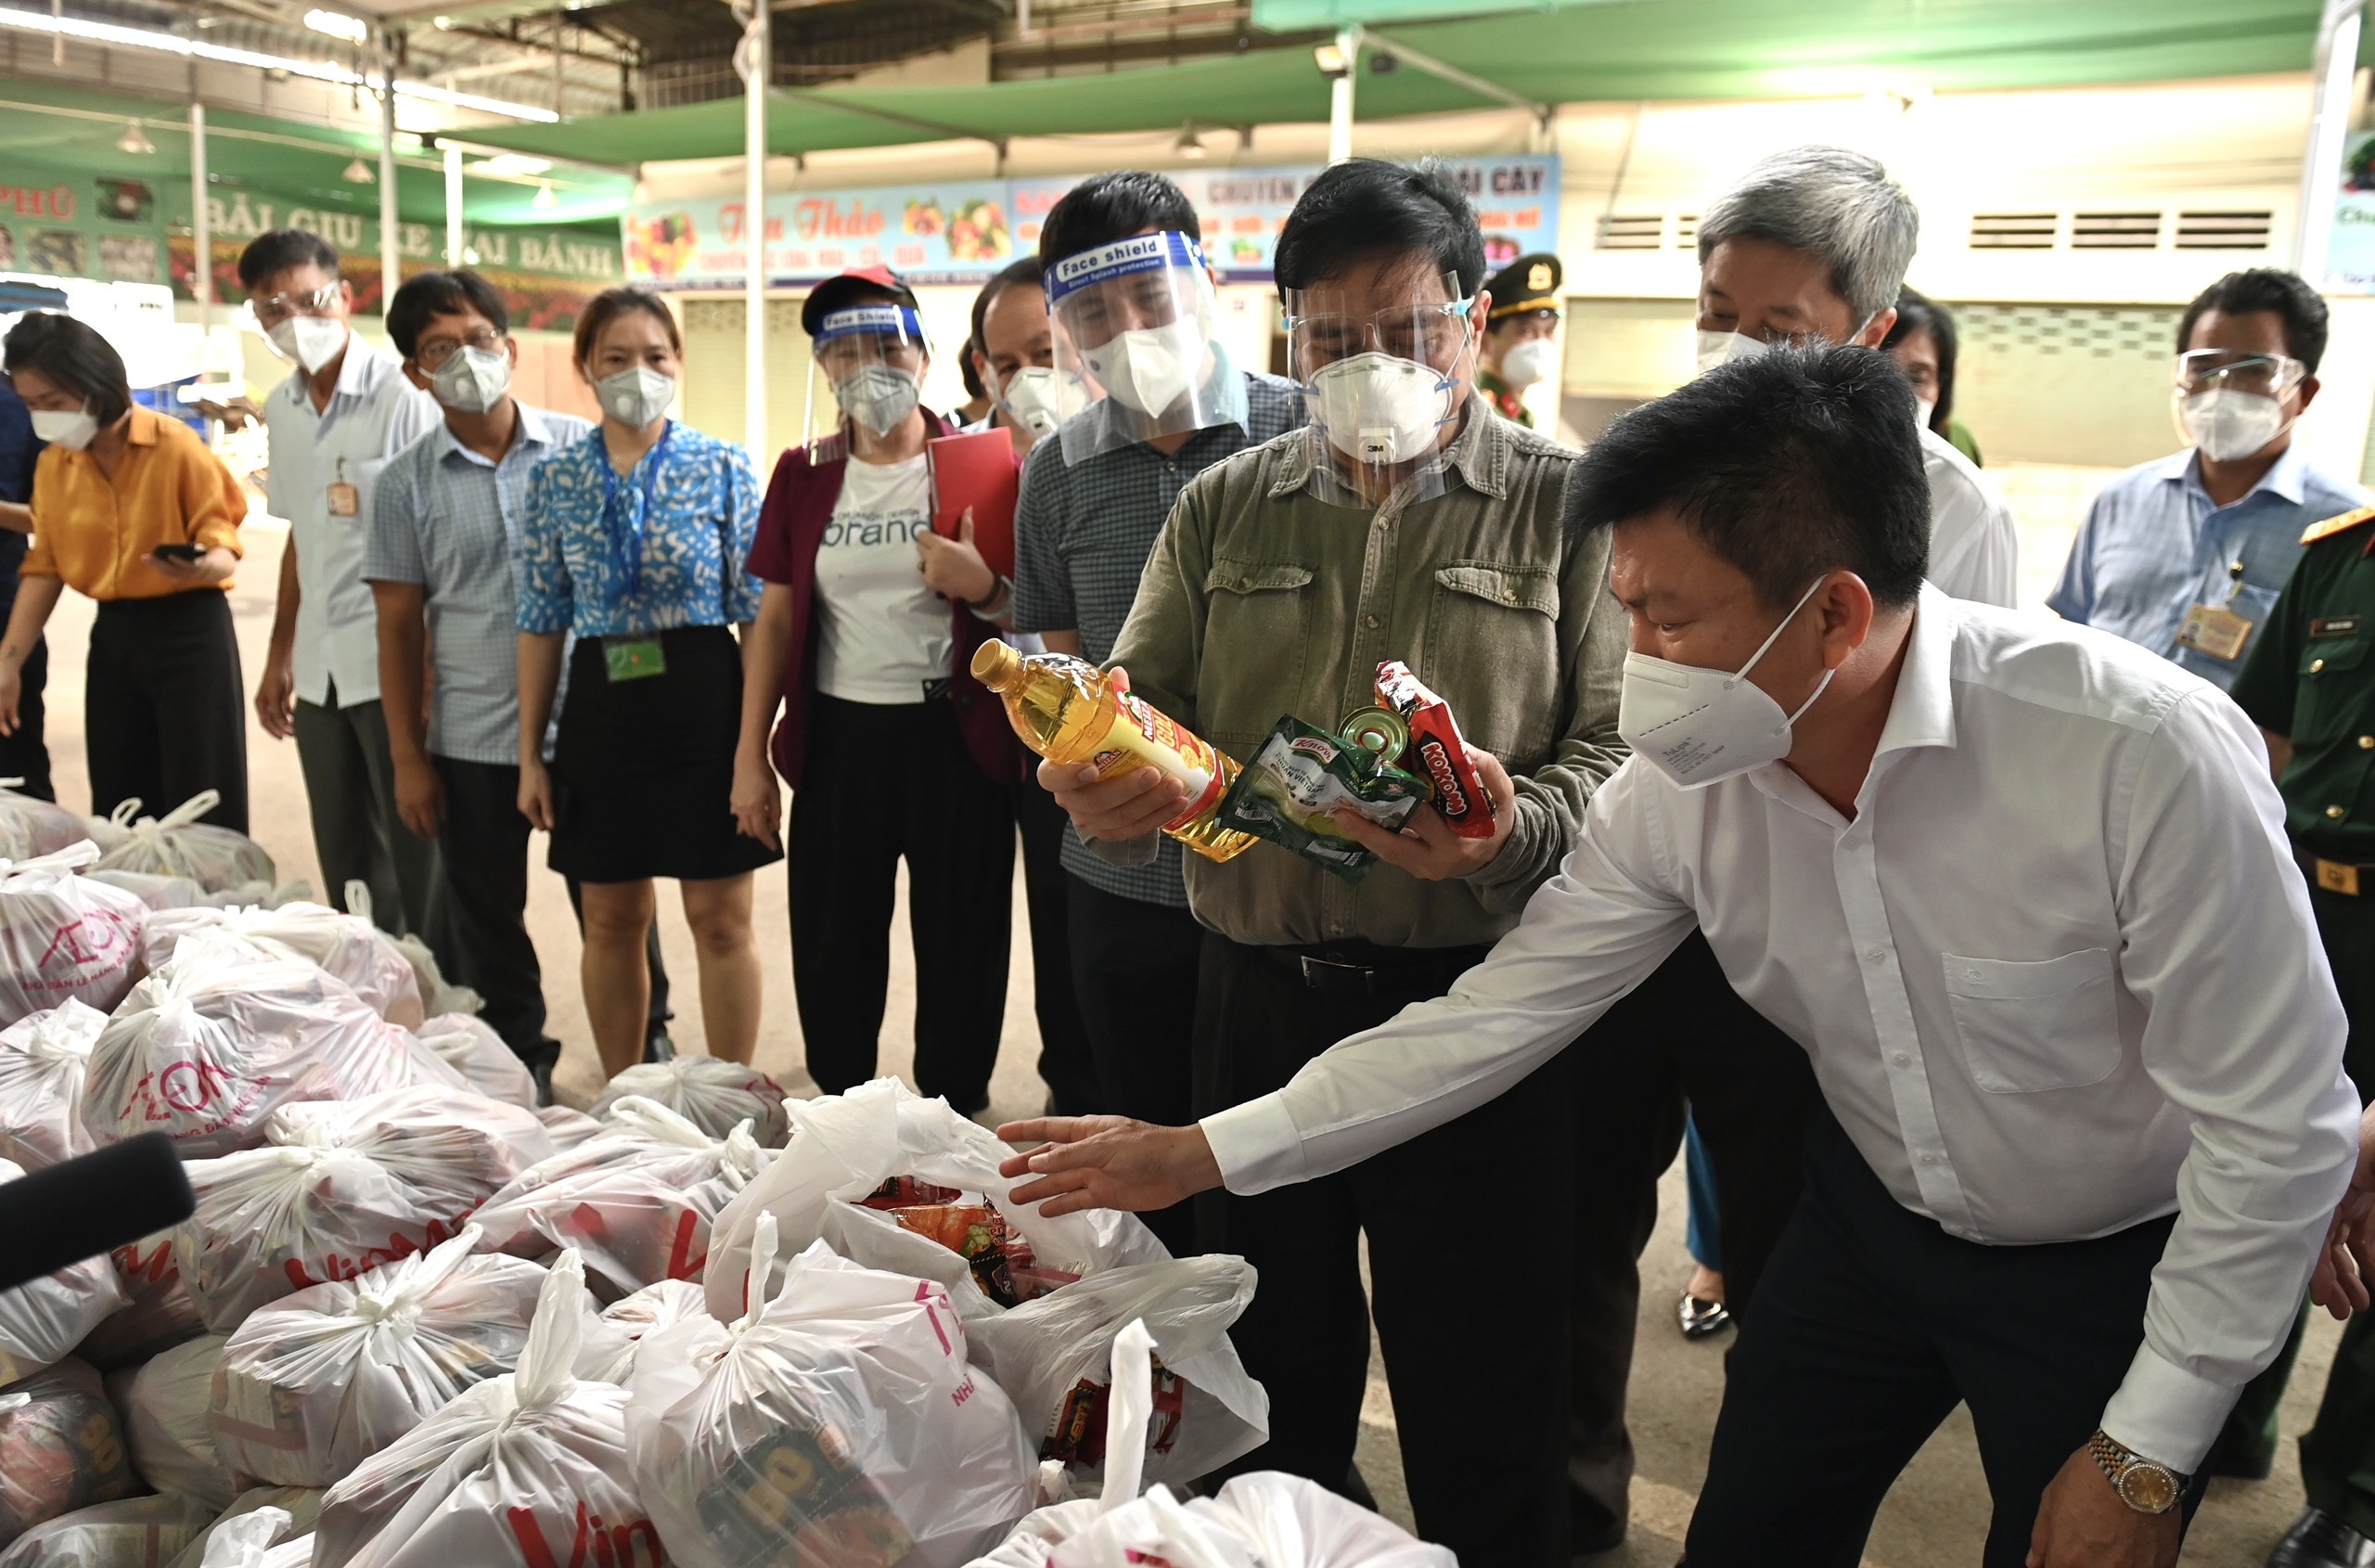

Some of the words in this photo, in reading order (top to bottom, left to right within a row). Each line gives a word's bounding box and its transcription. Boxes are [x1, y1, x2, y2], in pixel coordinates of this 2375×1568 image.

[376, 221, 433, 256] E
[444, 228, 508, 264] AI
[1062, 256, 1098, 276] Face
[1105, 239, 1157, 263] shield
[1118, 258, 1160, 275] protection
[1153, 705, 1176, 749] GOL
[1293, 738, 1333, 762] Knorr
[1420, 740, 1468, 816] KOKOMI
